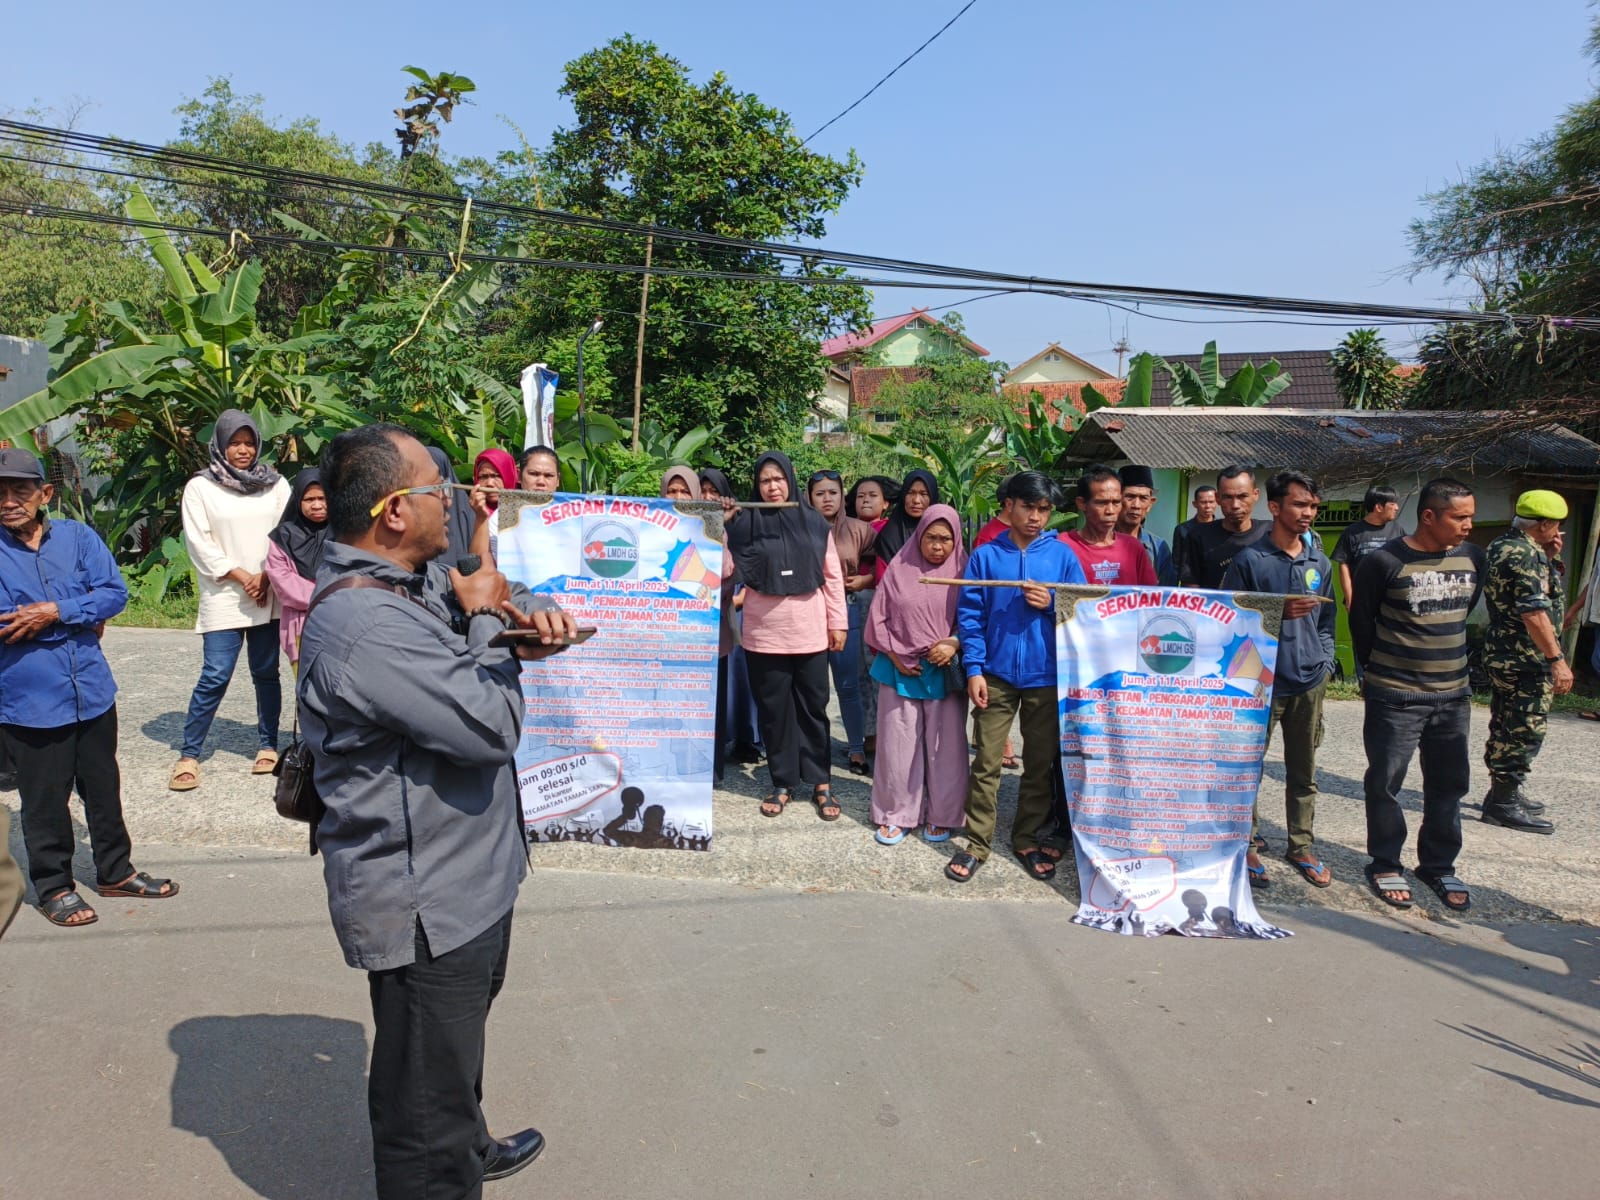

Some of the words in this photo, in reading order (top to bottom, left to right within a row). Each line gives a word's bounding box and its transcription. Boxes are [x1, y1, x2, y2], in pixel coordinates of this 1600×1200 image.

[542, 499, 604, 525] SERUAN
[607, 547, 626, 558] LMDH
[628, 549, 637, 559] GS
[604, 580, 614, 589] 11
[618, 580, 643, 592] April
[644, 582, 669, 591] 2025
[552, 595, 586, 605] PETANI
[593, 597, 650, 608] PENGGARAP
[653, 598, 673, 608] DAN
[676, 600, 709, 610] WARGA
[1097, 592, 1161, 618] SERUAN
[620, 609, 653, 621] TAMAN
[656, 611, 678, 622] SARI
[1162, 643, 1182, 653] LMDH
[1184, 644, 1194, 655] GS
[1159, 677, 1170, 685] 11
[1174, 678, 1199, 690] April
[1202, 679, 1224, 688] 2025
[1151, 694, 1207, 706] PENGGARAP
[1210, 697, 1228, 707] DAN
[1232, 698, 1264, 708] WARGA
[1116, 706, 1172, 717] KECAMATAN
[1176, 709, 1209, 719] TAMAN
[1212, 711, 1233, 720] SARI
[540, 763, 568, 780] 09:00
[569, 756, 587, 770] s/d
[537, 773, 574, 794] selesai
[525, 799, 564, 816] KECAMATAN
[564, 791, 588, 802] TAMAN
[1124, 860, 1142, 873] s/d
